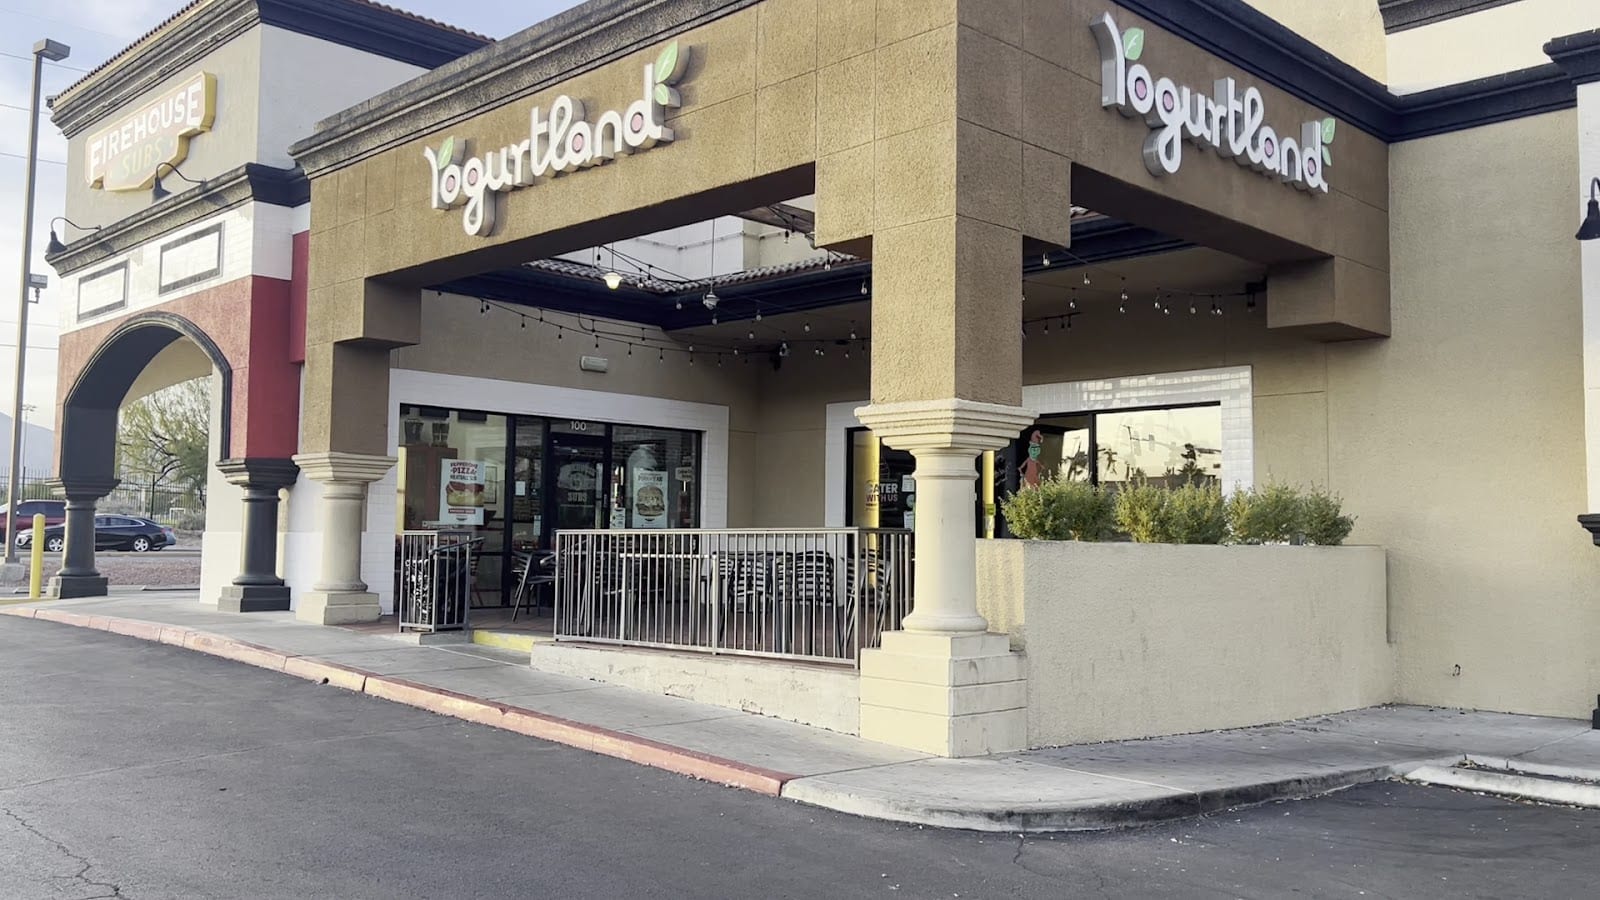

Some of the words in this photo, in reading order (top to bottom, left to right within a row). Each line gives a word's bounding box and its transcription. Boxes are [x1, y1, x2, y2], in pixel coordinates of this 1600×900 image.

[1092, 11, 1332, 194] Yogurtland
[89, 79, 202, 184] FIREHOUSE
[424, 60, 676, 237] Yogurtland
[122, 138, 163, 178] SUBS
[570, 420, 587, 431] 100
[865, 483, 898, 493] CATER
[887, 494, 899, 502] US
